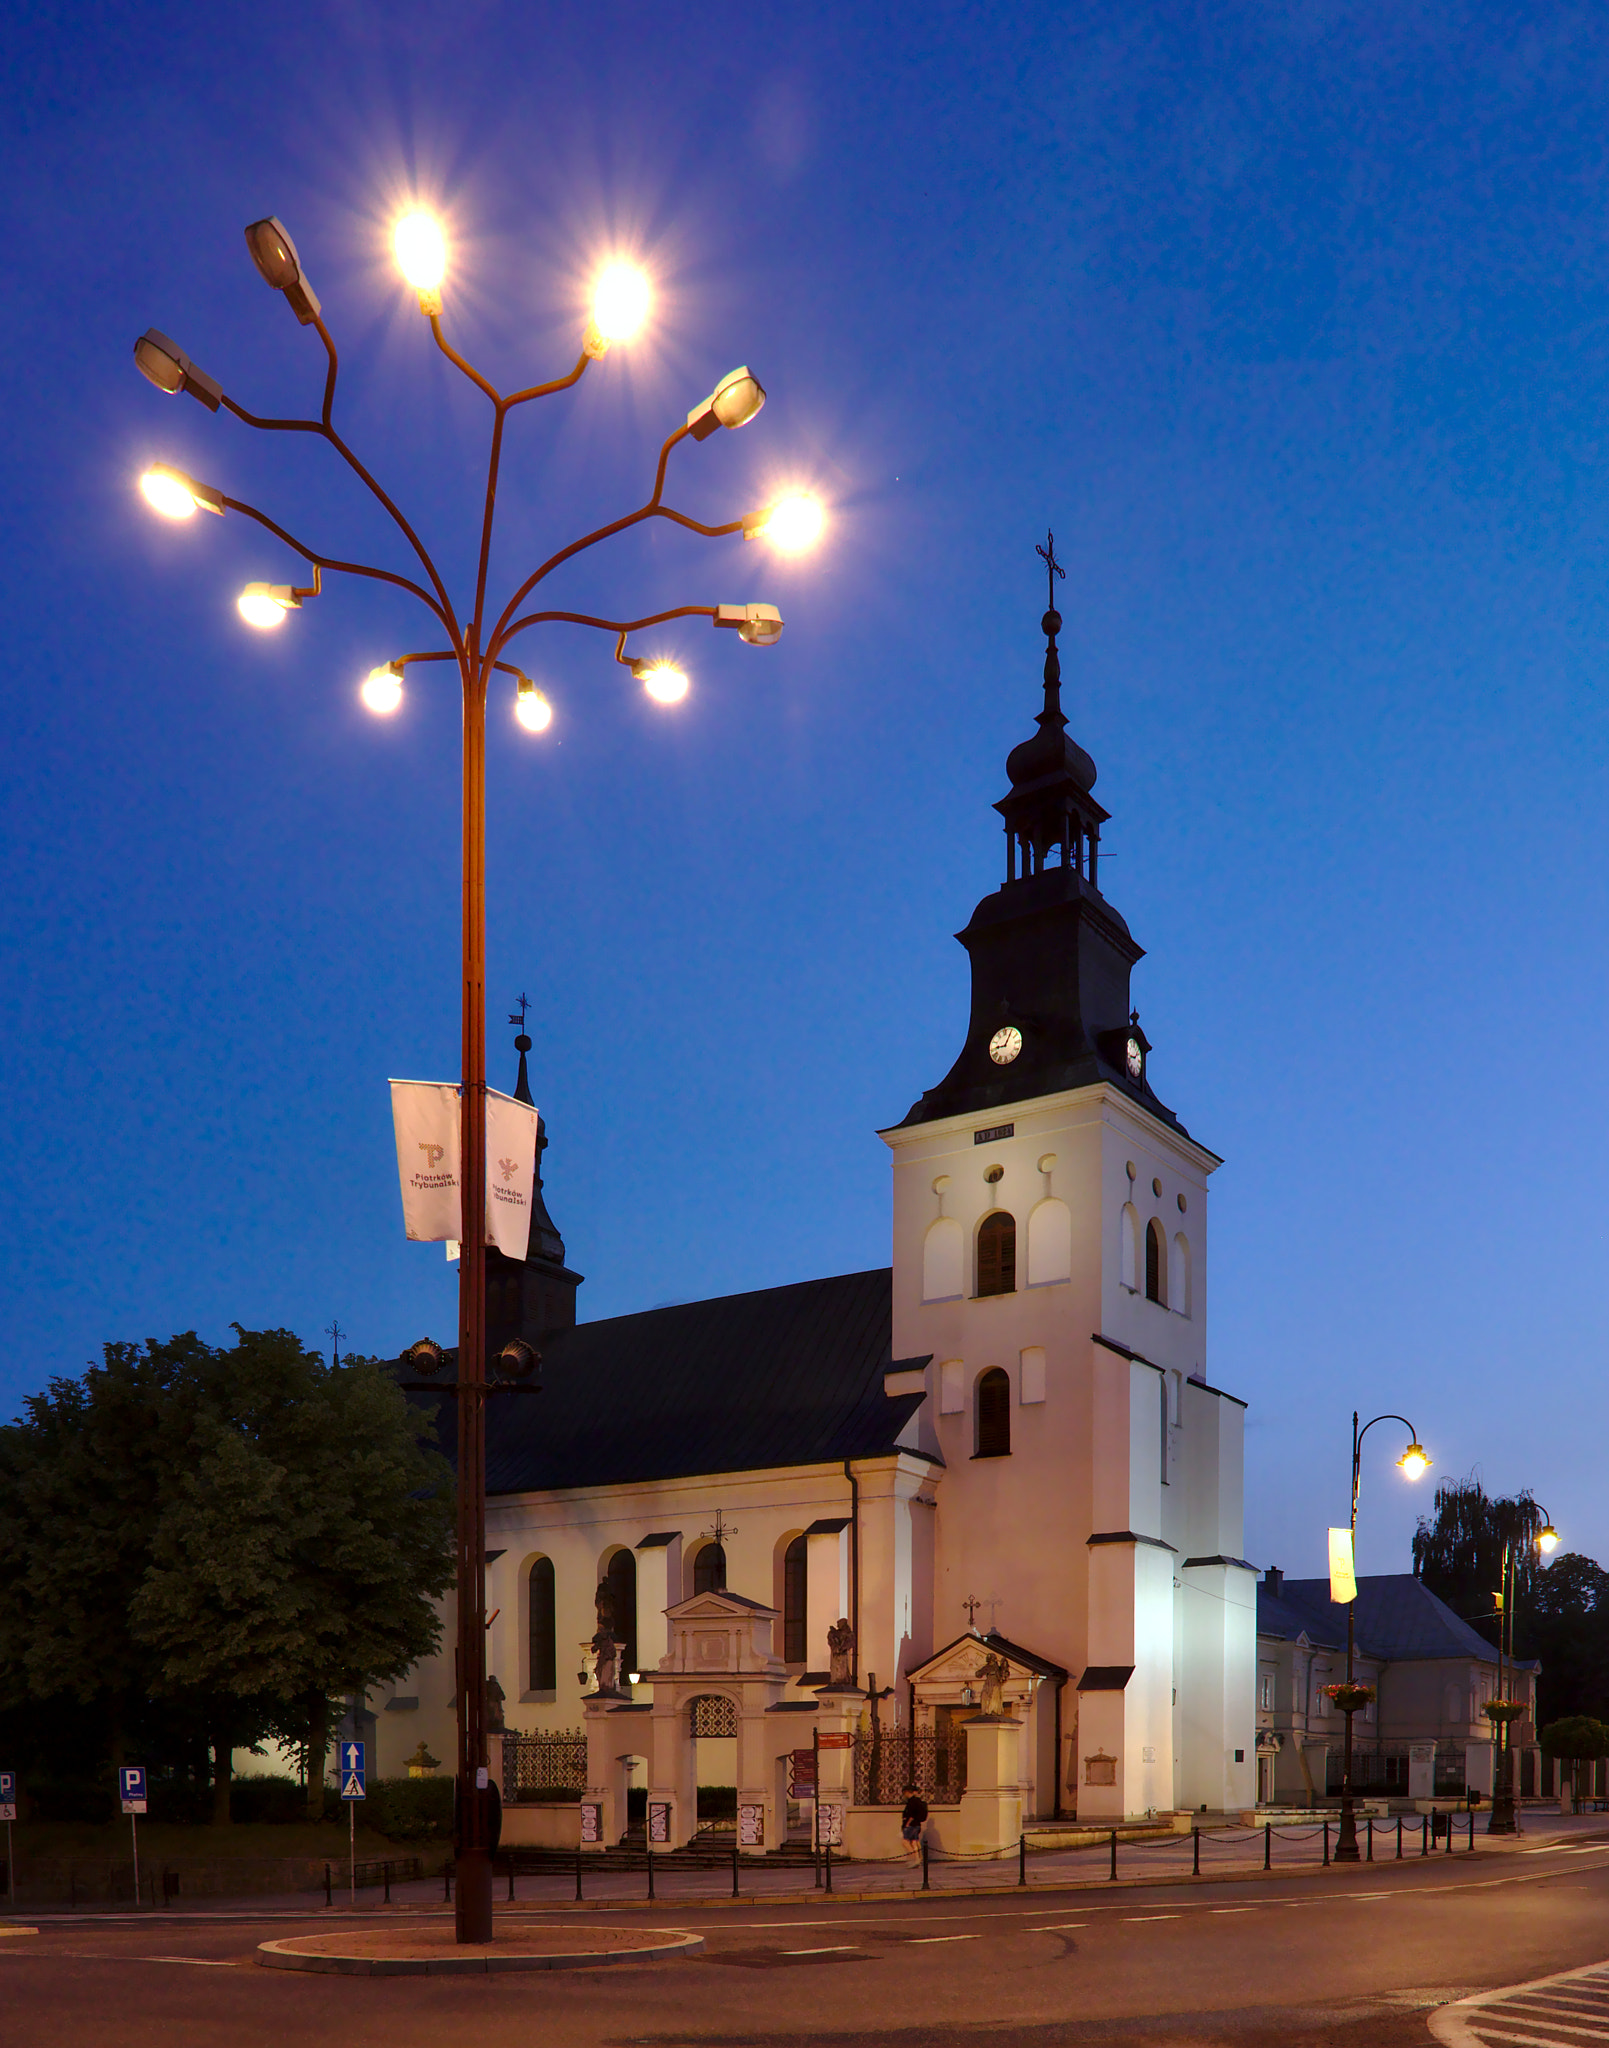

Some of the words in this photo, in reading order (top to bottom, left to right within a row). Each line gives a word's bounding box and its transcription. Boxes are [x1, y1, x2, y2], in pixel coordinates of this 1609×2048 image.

[415, 1173, 453, 1182] Piotrków
[410, 1179, 459, 1190] Trybunalski
[125, 1769, 141, 1791] P
